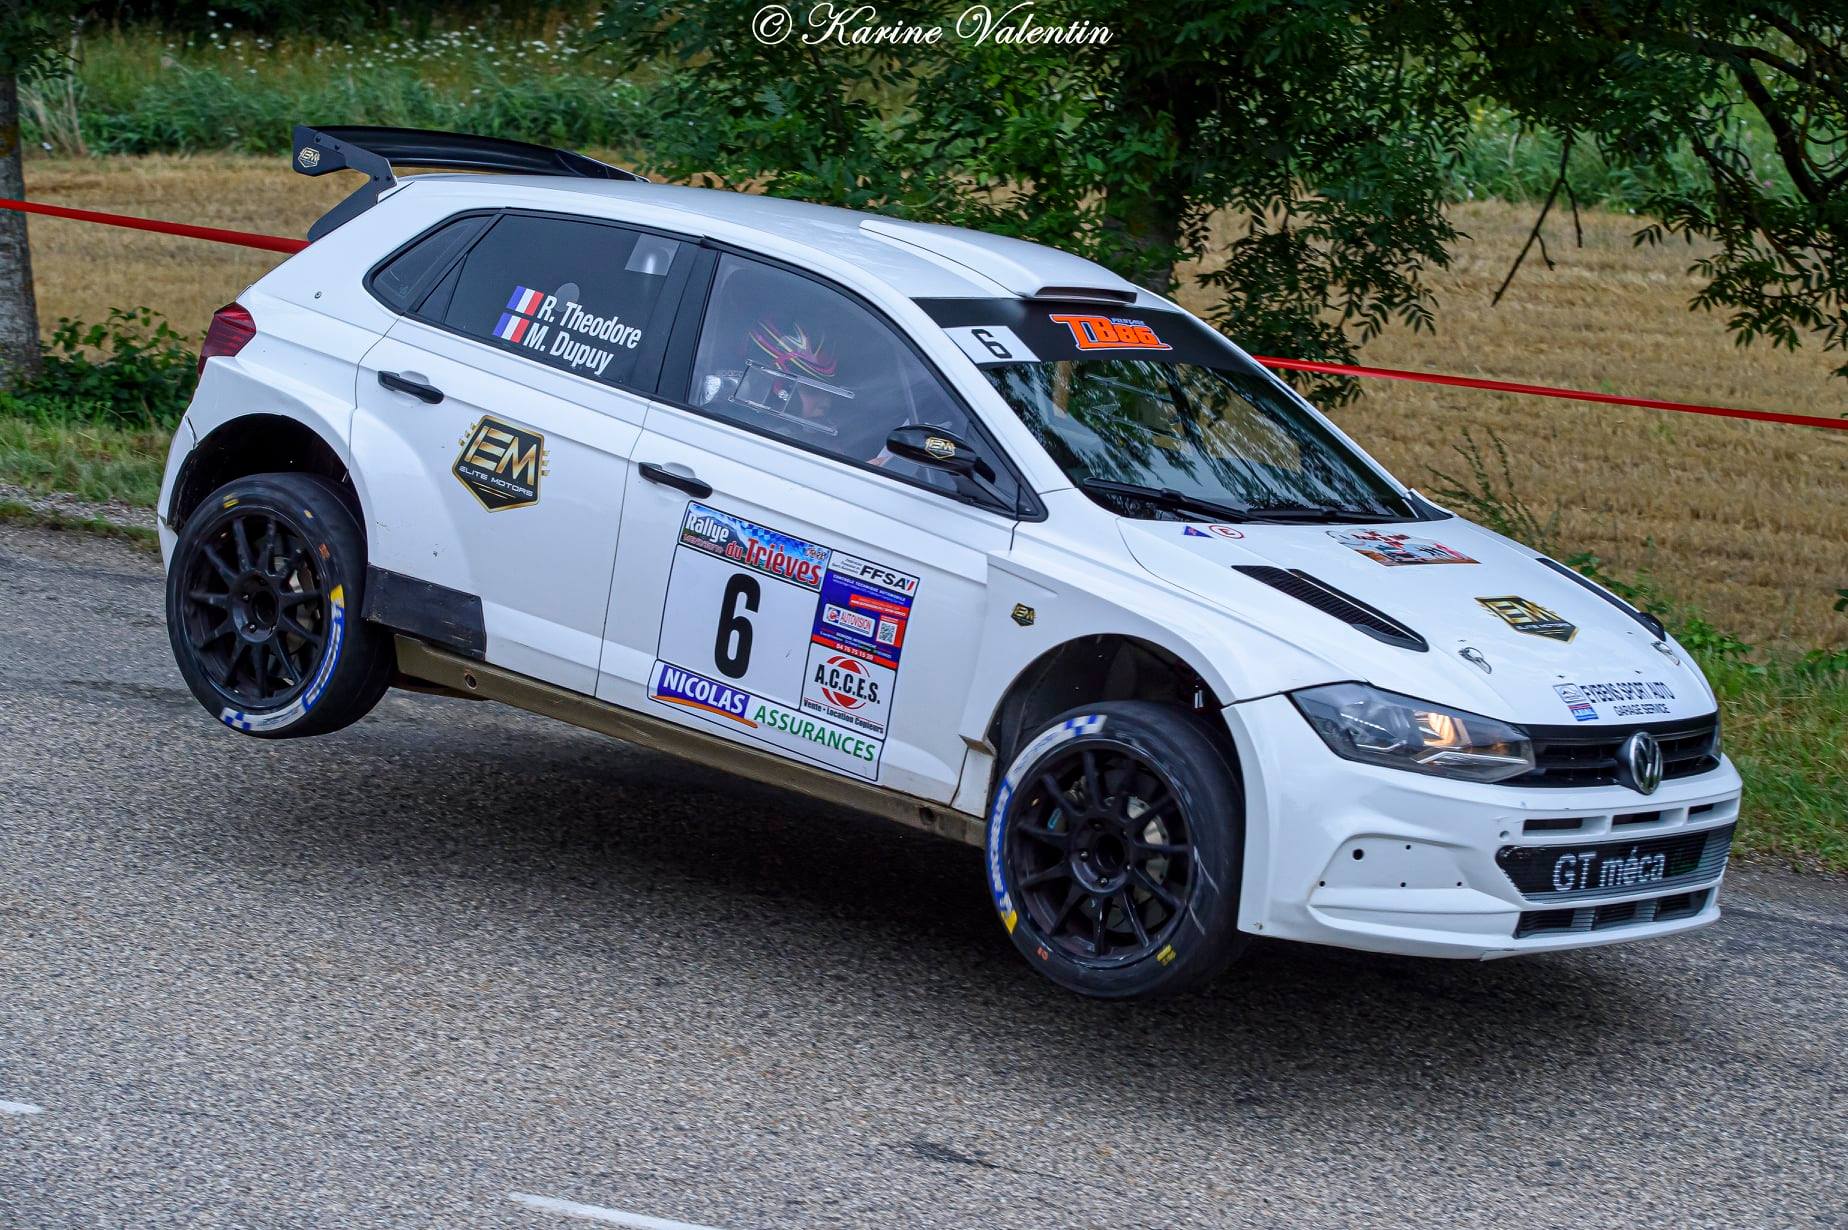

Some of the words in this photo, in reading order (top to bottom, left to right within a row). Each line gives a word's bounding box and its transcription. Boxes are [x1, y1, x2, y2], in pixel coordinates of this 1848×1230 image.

[537, 295, 558, 323] R.
[560, 301, 642, 349] Theodore
[971, 328, 1013, 359] 6
[523, 322, 549, 352] M.
[550, 331, 614, 376] Dupuy
[464, 425, 537, 486] EM
[459, 465, 489, 481] ELITE
[491, 477, 534, 497] MOTORS
[685, 510, 730, 543] Rallye
[725, 540, 743, 560] du
[744, 537, 823, 586] Trièves
[859, 564, 907, 591] FFSA
[714, 573, 761, 680] 6
[814, 663, 881, 705] A.C.C.E.S.
[1616, 681, 1653, 701] SPORT
[1646, 681, 1676, 700] AUTO
[663, 668, 746, 714] NICOLAS
[754, 705, 876, 762] ASSURANCES
[803, 699, 822, 712] Vente
[827, 707, 854, 724] Location
[1613, 703, 1645, 717] GARAGE
[1640, 703, 1671, 715] SERVICE
[1553, 851, 1597, 891] GT
[1599, 845, 1666, 887] méca
